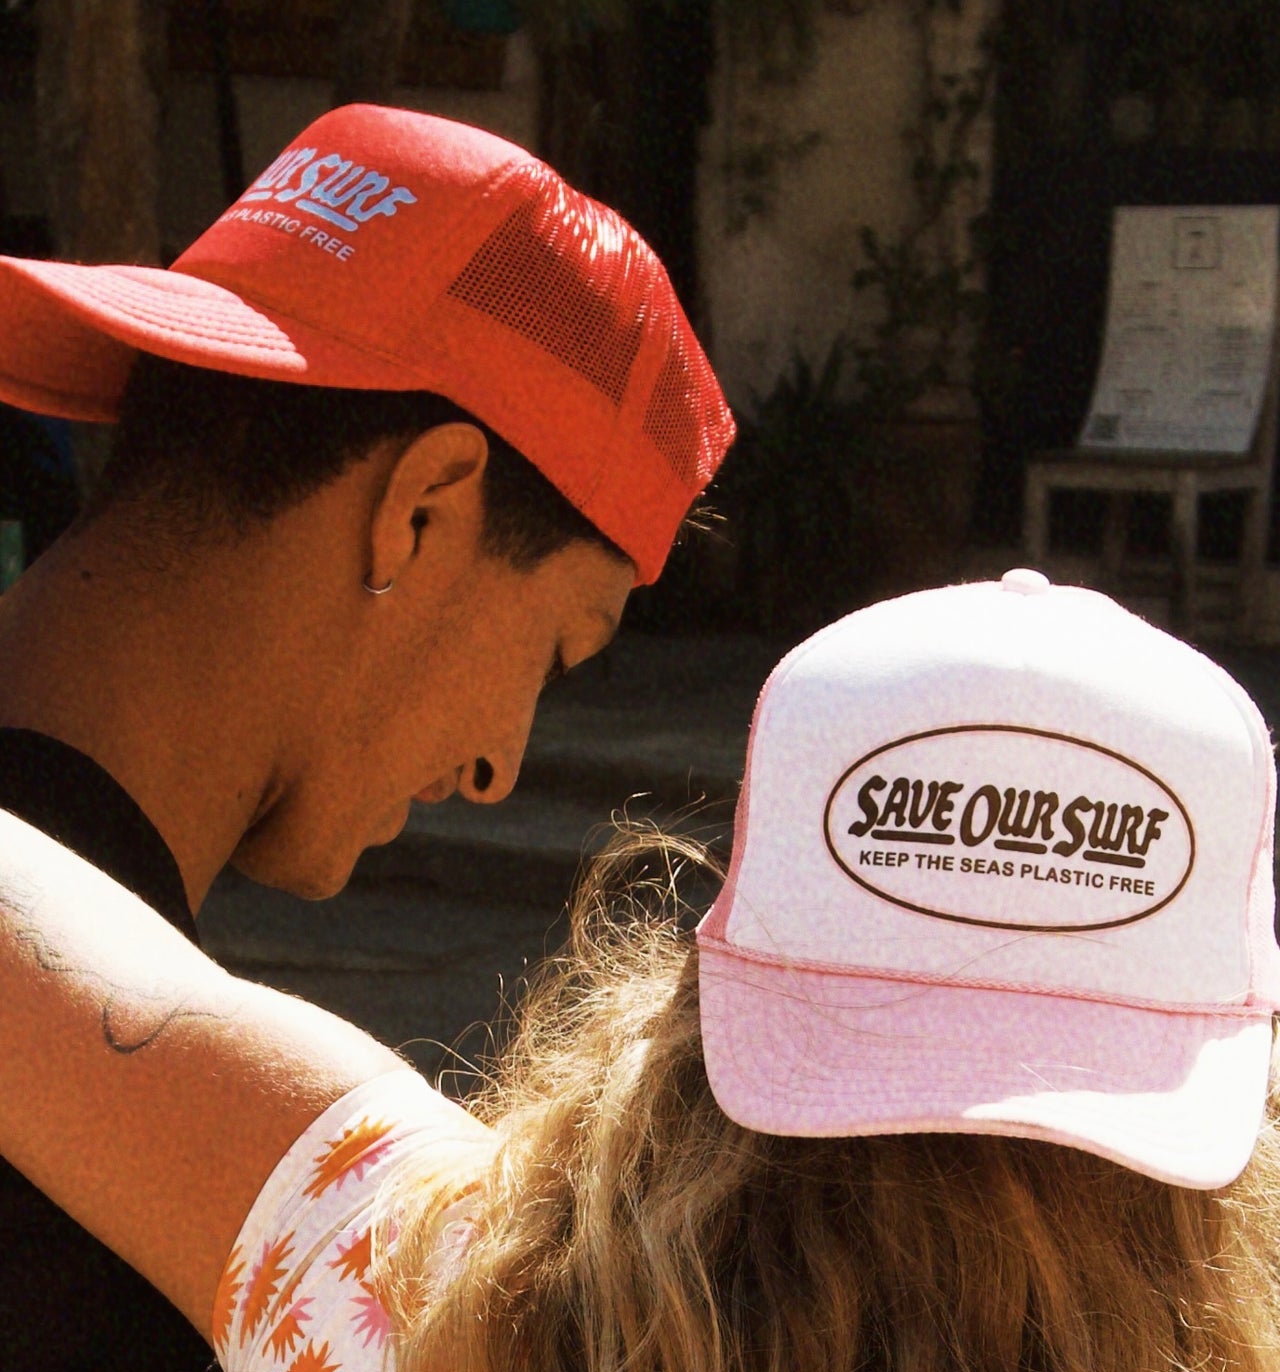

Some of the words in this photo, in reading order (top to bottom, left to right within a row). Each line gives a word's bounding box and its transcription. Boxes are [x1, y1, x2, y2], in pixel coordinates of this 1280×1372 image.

[253, 147, 318, 190] UR
[275, 153, 419, 222] SURF
[232, 207, 300, 235] PLASTIC
[300, 225, 356, 263] FREE
[848, 774, 964, 837] SAVE
[959, 783, 1060, 848] OUR
[1052, 795, 1171, 859] SURF
[859, 850, 910, 868] KEEP
[914, 853, 955, 872] THE
[960, 858, 1015, 878] SEAS
[1020, 864, 1105, 889] PLASTIC
[1109, 876, 1156, 897] FREE
